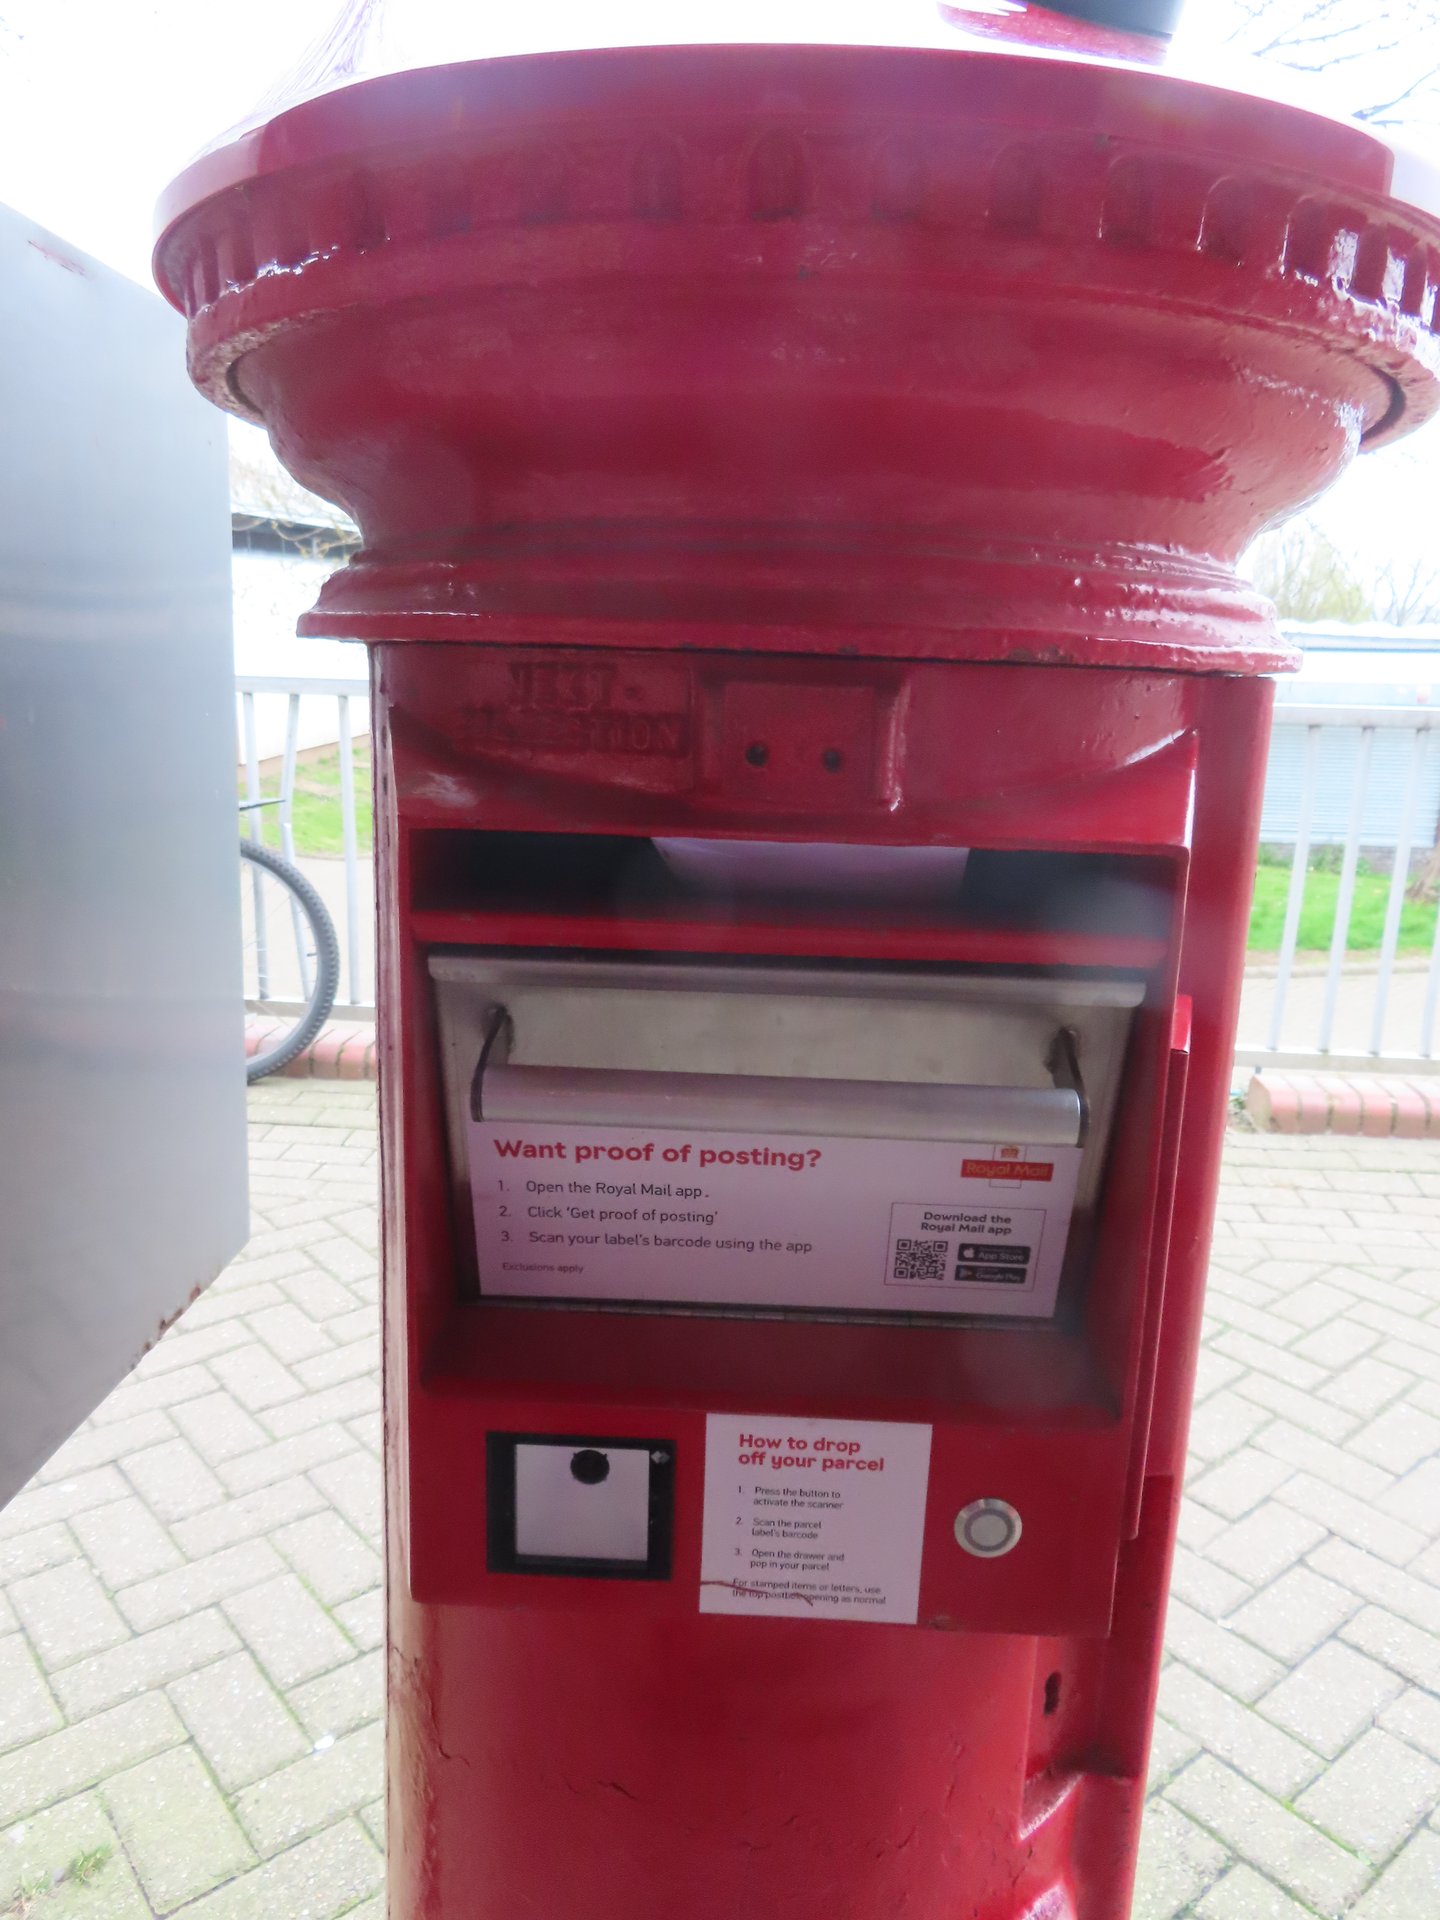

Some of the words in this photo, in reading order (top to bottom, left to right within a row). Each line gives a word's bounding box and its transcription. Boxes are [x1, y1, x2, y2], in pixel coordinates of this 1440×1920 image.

[494, 1139, 566, 1160] Want
[575, 1143, 654, 1164] proof
[662, 1144, 691, 1163] of
[700, 1147, 822, 1172] posting?
[967, 1163, 1010, 1177] Royal
[1014, 1165, 1049, 1178] Mail
[498, 1180, 511, 1192] 1.
[526, 1180, 563, 1196] Open
[568, 1181, 591, 1195] the
[595, 1182, 637, 1199] Royal
[640, 1183, 672, 1197] Mail
[499, 1205, 512, 1218] 2.
[527, 1205, 562, 1219] Click
[566, 1206, 595, 1220] 'Get
[599, 1208, 638, 1224] proof
[641, 1208, 657, 1221] of
[660, 1210, 718, 1226] posting'
[923, 1211, 987, 1223] Download
[990, 1214, 1012, 1225] the
[920, 1222, 955, 1234] Royal
[958, 1223, 985, 1233] Mail
[988, 1226, 1012, 1236] app
[501, 1230, 513, 1243] 3.
[529, 1230, 564, 1244] Scan
[567, 1233, 600, 1248] your
[604, 1232, 650, 1246] label's
[654, 1234, 711, 1249] barcode
[715, 1238, 755, 1253] using
[759, 1238, 782, 1252] the
[785, 1241, 813, 1255] app
[978, 1251, 998, 1262] App
[1000, 1253, 1025, 1262] Store
[502, 1261, 555, 1273] Exclusions
[557, 1263, 584, 1275] apply
[738, 1433, 782, 1449] How
[787, 1436, 808, 1450] to
[813, 1437, 861, 1455] drop
[738, 1451, 766, 1465] off
[771, 1454, 816, 1470] your
[822, 1457, 884, 1472] parcel
[754, 1486, 781, 1497] Press
[783, 1487, 798, 1497] the
[799, 1488, 830, 1499] button
[831, 1489, 841, 1499] to
[753, 1498, 789, 1508] activate
[790, 1499, 805, 1508] the
[807, 1500, 844, 1510] scanner
[752, 1517, 775, 1528] Scan
[777, 1518, 792, 1528] the
[793, 1520, 821, 1531] parcel
[751, 1527, 780, 1538] label's
[782, 1529, 818, 1540] barcode
[751, 1548, 775, 1561] Open
[777, 1549, 791, 1560] the
[793, 1551, 825, 1562] drawer
[827, 1552, 845, 1563] and
[749, 1560, 767, 1570] pop
[769, 1560, 778, 1569] in
[779, 1562, 799, 1572] your
[801, 1561, 830, 1572] parcel
[732, 1577, 749, 1588] For
[750, 1579, 790, 1591] stamped
[791, 1580, 817, 1591] items
[818, 1583, 829, 1592] or
[830, 1582, 863, 1594] letters,
[864, 1586, 881, 1595] use
[764, 1590, 802, 1602] postbo
[841, 1595, 851, 1604] as
[853, 1595, 887, 1606] normal
